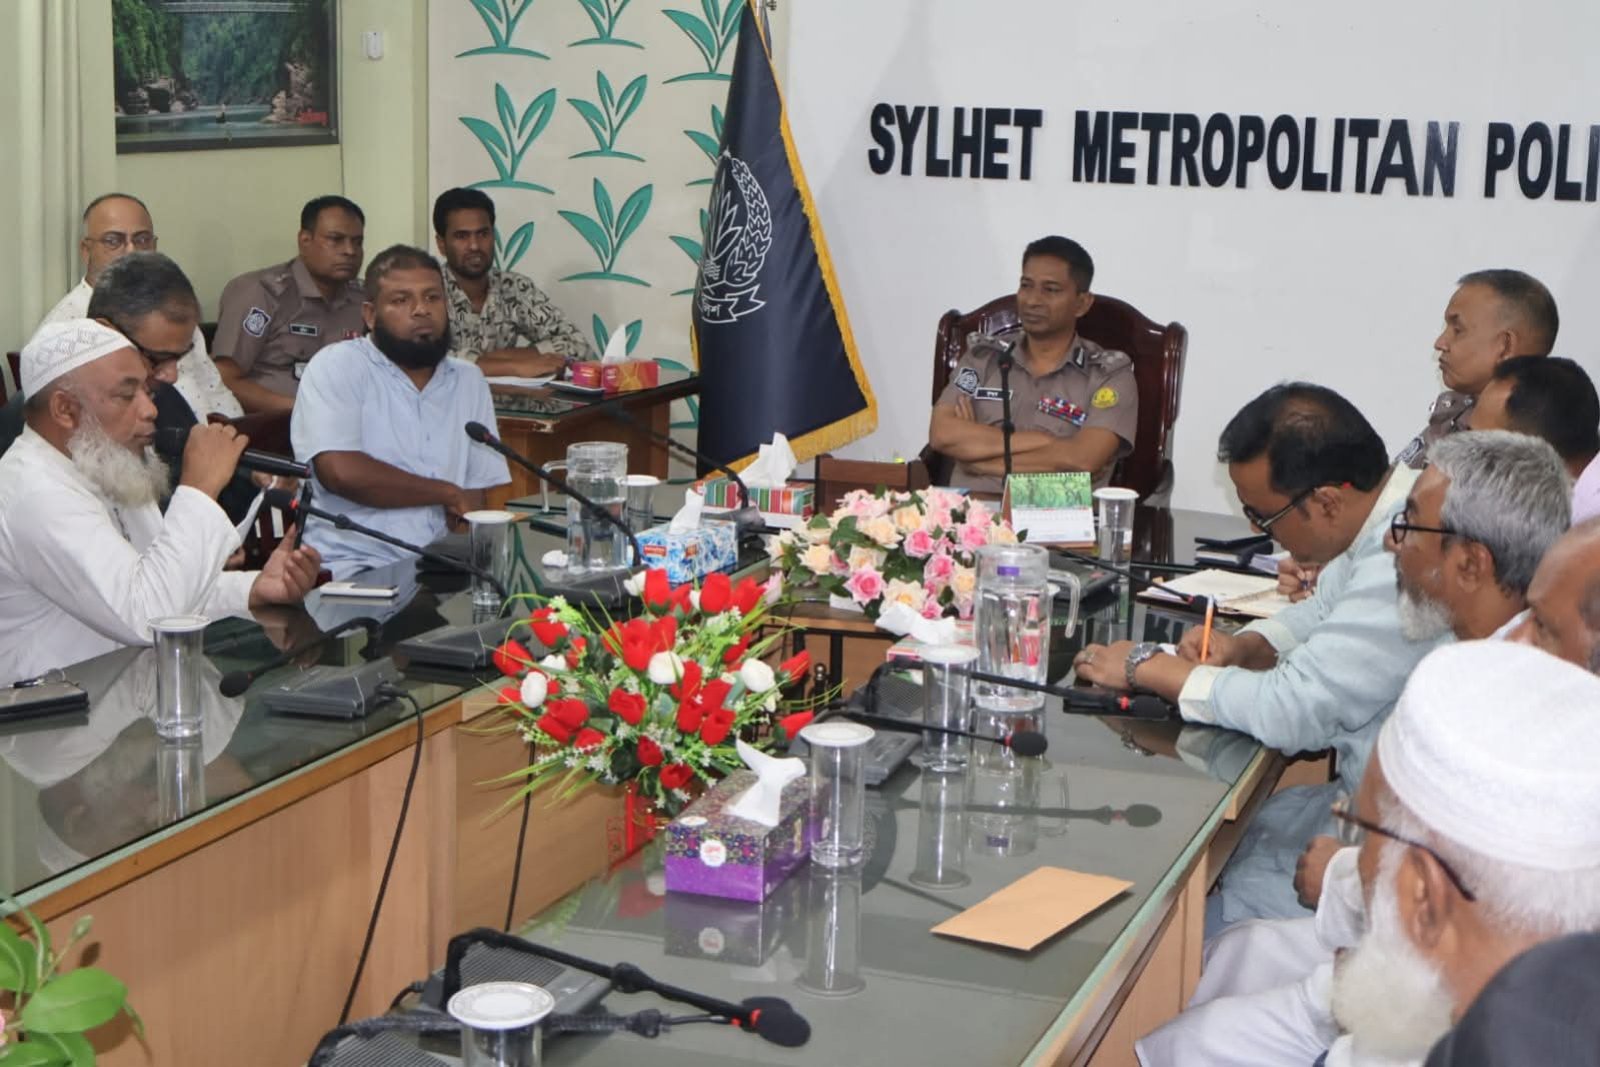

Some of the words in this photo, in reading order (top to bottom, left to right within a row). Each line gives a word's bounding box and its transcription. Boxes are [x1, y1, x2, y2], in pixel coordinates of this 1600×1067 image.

[868, 102, 1043, 181] SYLHET
[1072, 110, 1464, 198] METROPOLITAN
[1484, 121, 1600, 203] POLI
